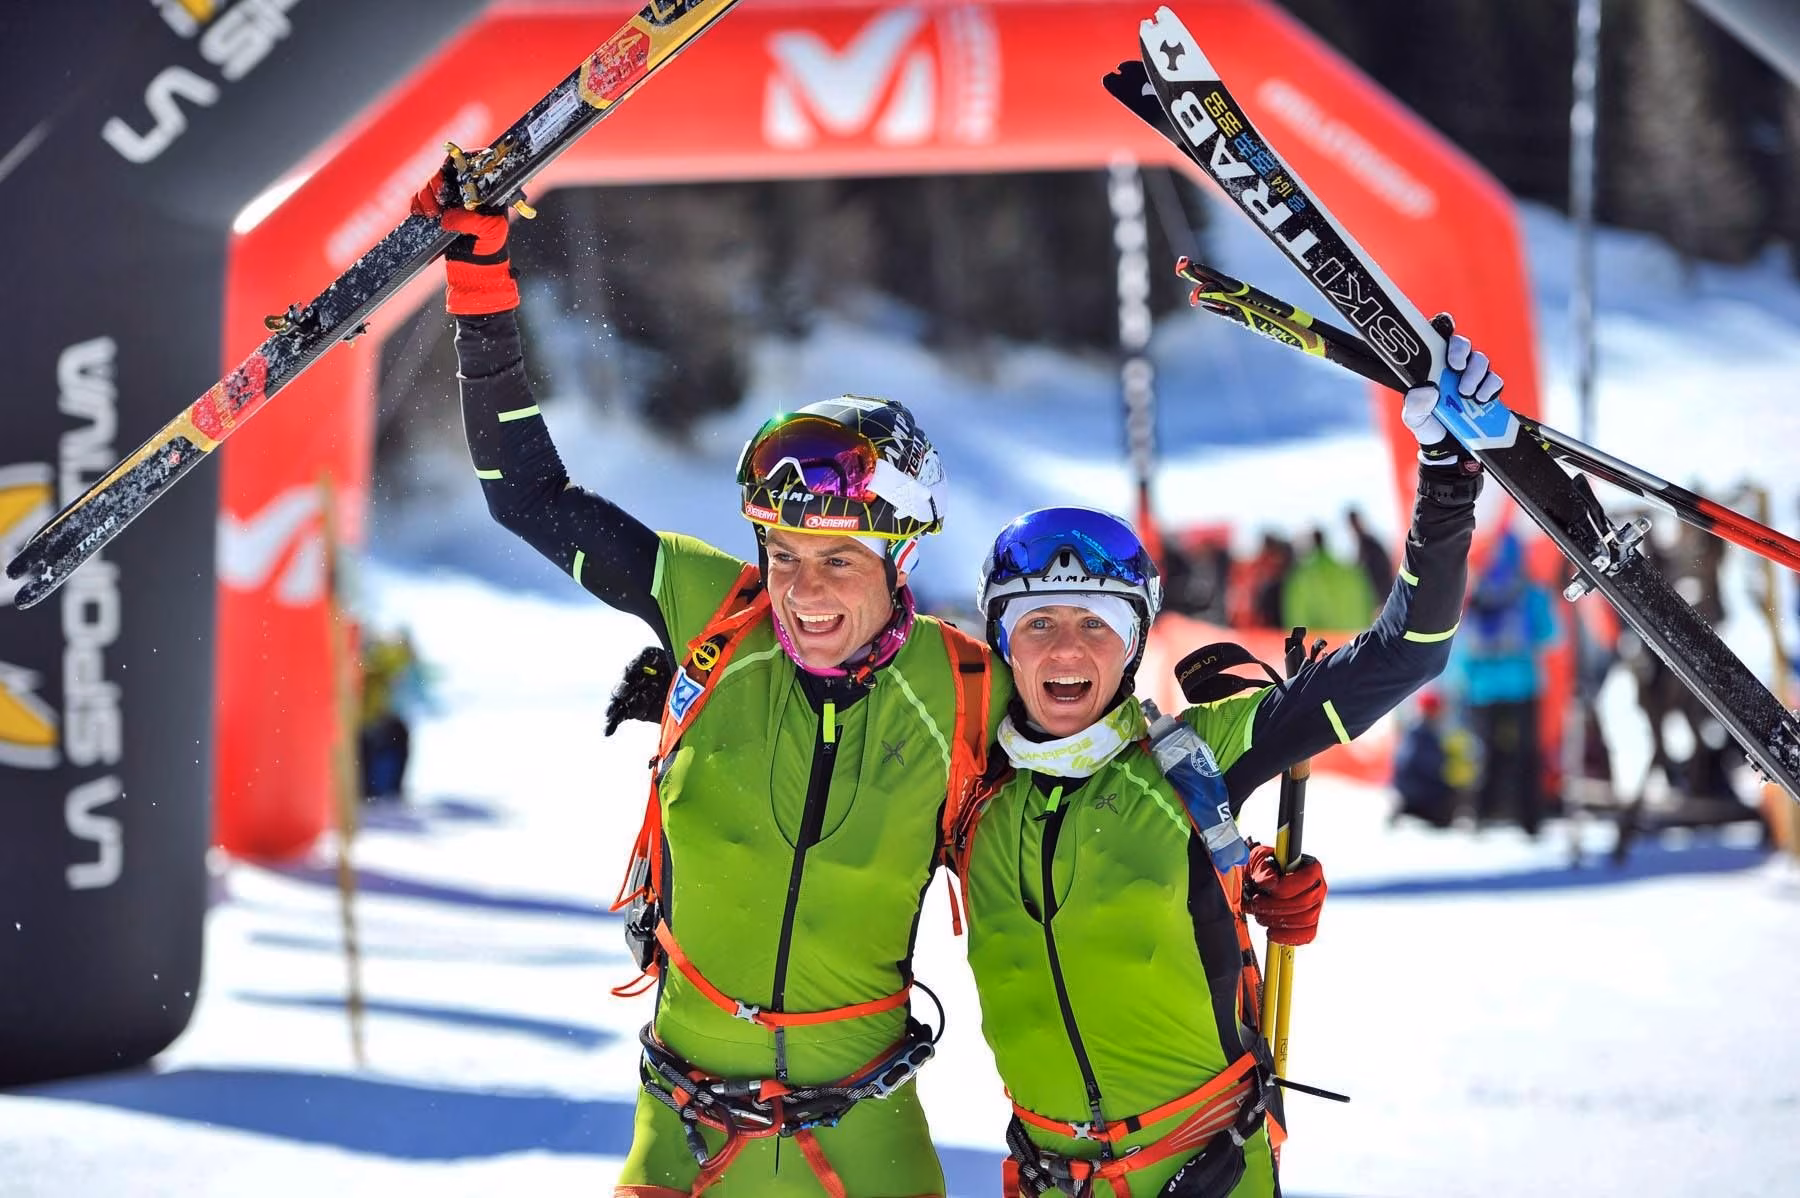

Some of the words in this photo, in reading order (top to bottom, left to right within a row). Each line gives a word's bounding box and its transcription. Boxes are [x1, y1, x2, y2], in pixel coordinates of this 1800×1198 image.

[102, 65, 220, 164] LA
[1271, 175, 1294, 198] 164
[1259, 322, 1297, 344] LEKI
[884, 413, 910, 466] AMP
[770, 490, 815, 503] CAMP
[752, 508, 778, 521] ENERVIT
[821, 519, 859, 529] ENERVIT
[76, 516, 118, 551] TRAB
[57, 335, 122, 766] SPOIVA
[1041, 575, 1090, 583] CAMP
[65, 774, 123, 890] LA
